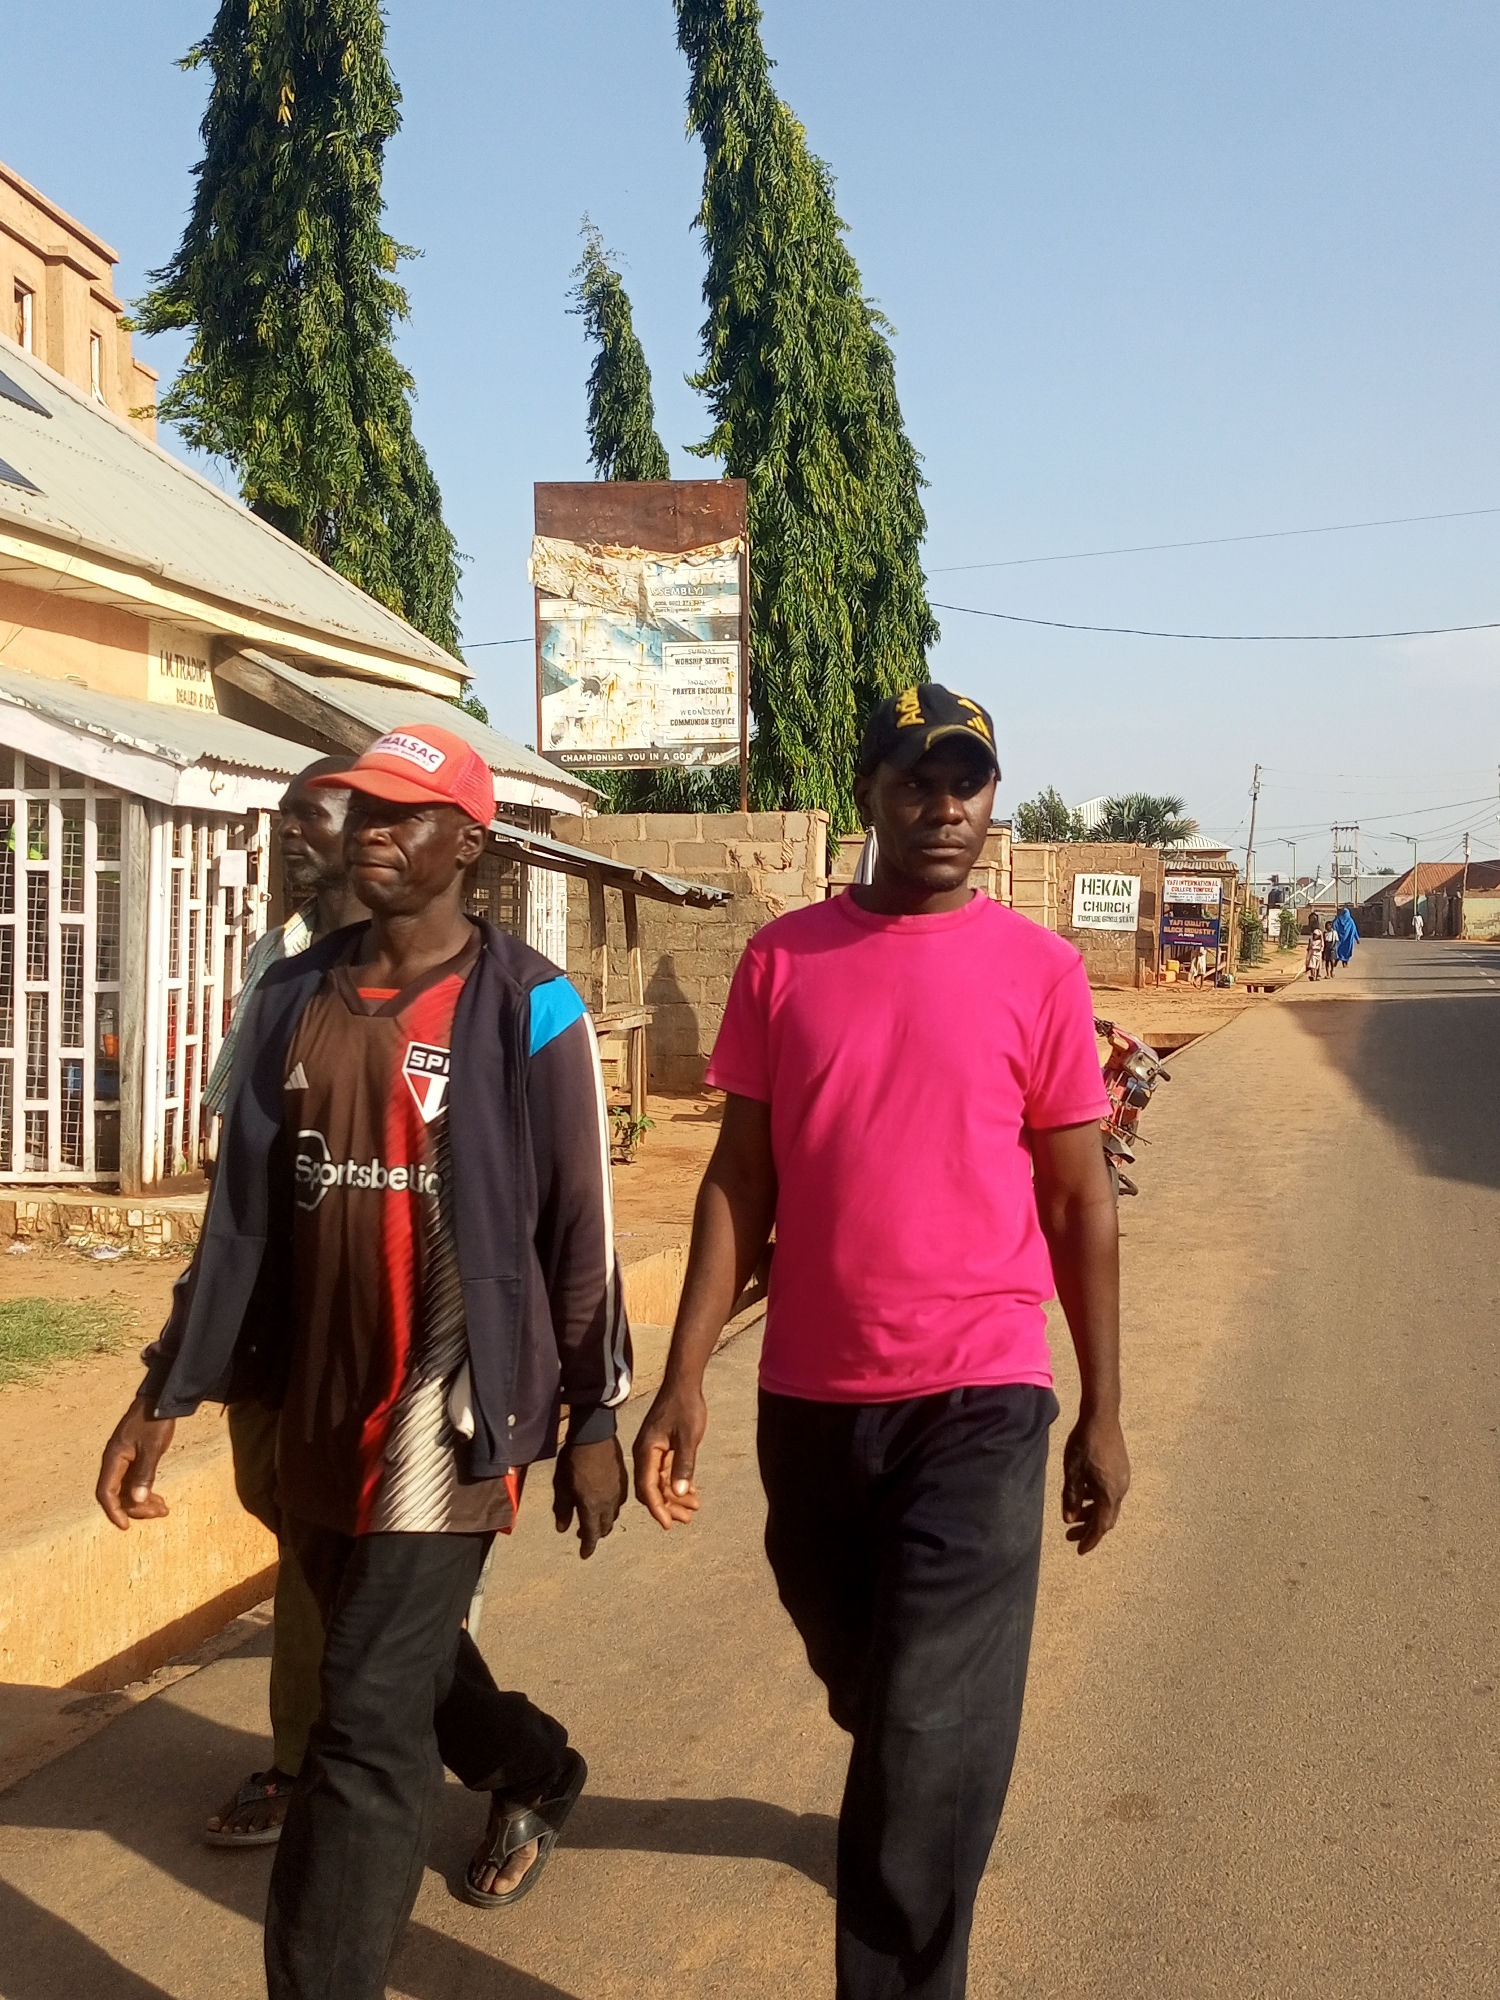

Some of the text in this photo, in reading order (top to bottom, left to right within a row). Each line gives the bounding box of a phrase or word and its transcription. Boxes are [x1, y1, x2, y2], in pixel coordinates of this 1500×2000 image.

[675, 657, 730, 665] WORSHIP SERVICE
[672, 686, 733, 695] PRAYER ENCOUNTER
[199, 693, 203, 707] &
[680, 708, 725, 716] WEDNESDAY
[670, 717, 735, 726] COMMUNION SERVICE
[560, 753, 624, 762] CHAMPIONING
[627, 753, 646, 761] YOU
[650, 753, 660, 761] IN
[663, 753, 670, 761] A
[672, 752, 703, 761] GODY
[1081, 878, 1132, 897] HEKAN
[1083, 901, 1131, 914] CHURCH
[1118, 916, 1135, 924] STATE
[1184, 920, 1211, 928] QUALITY
[1184, 927, 1216, 936] INDUSTRY
